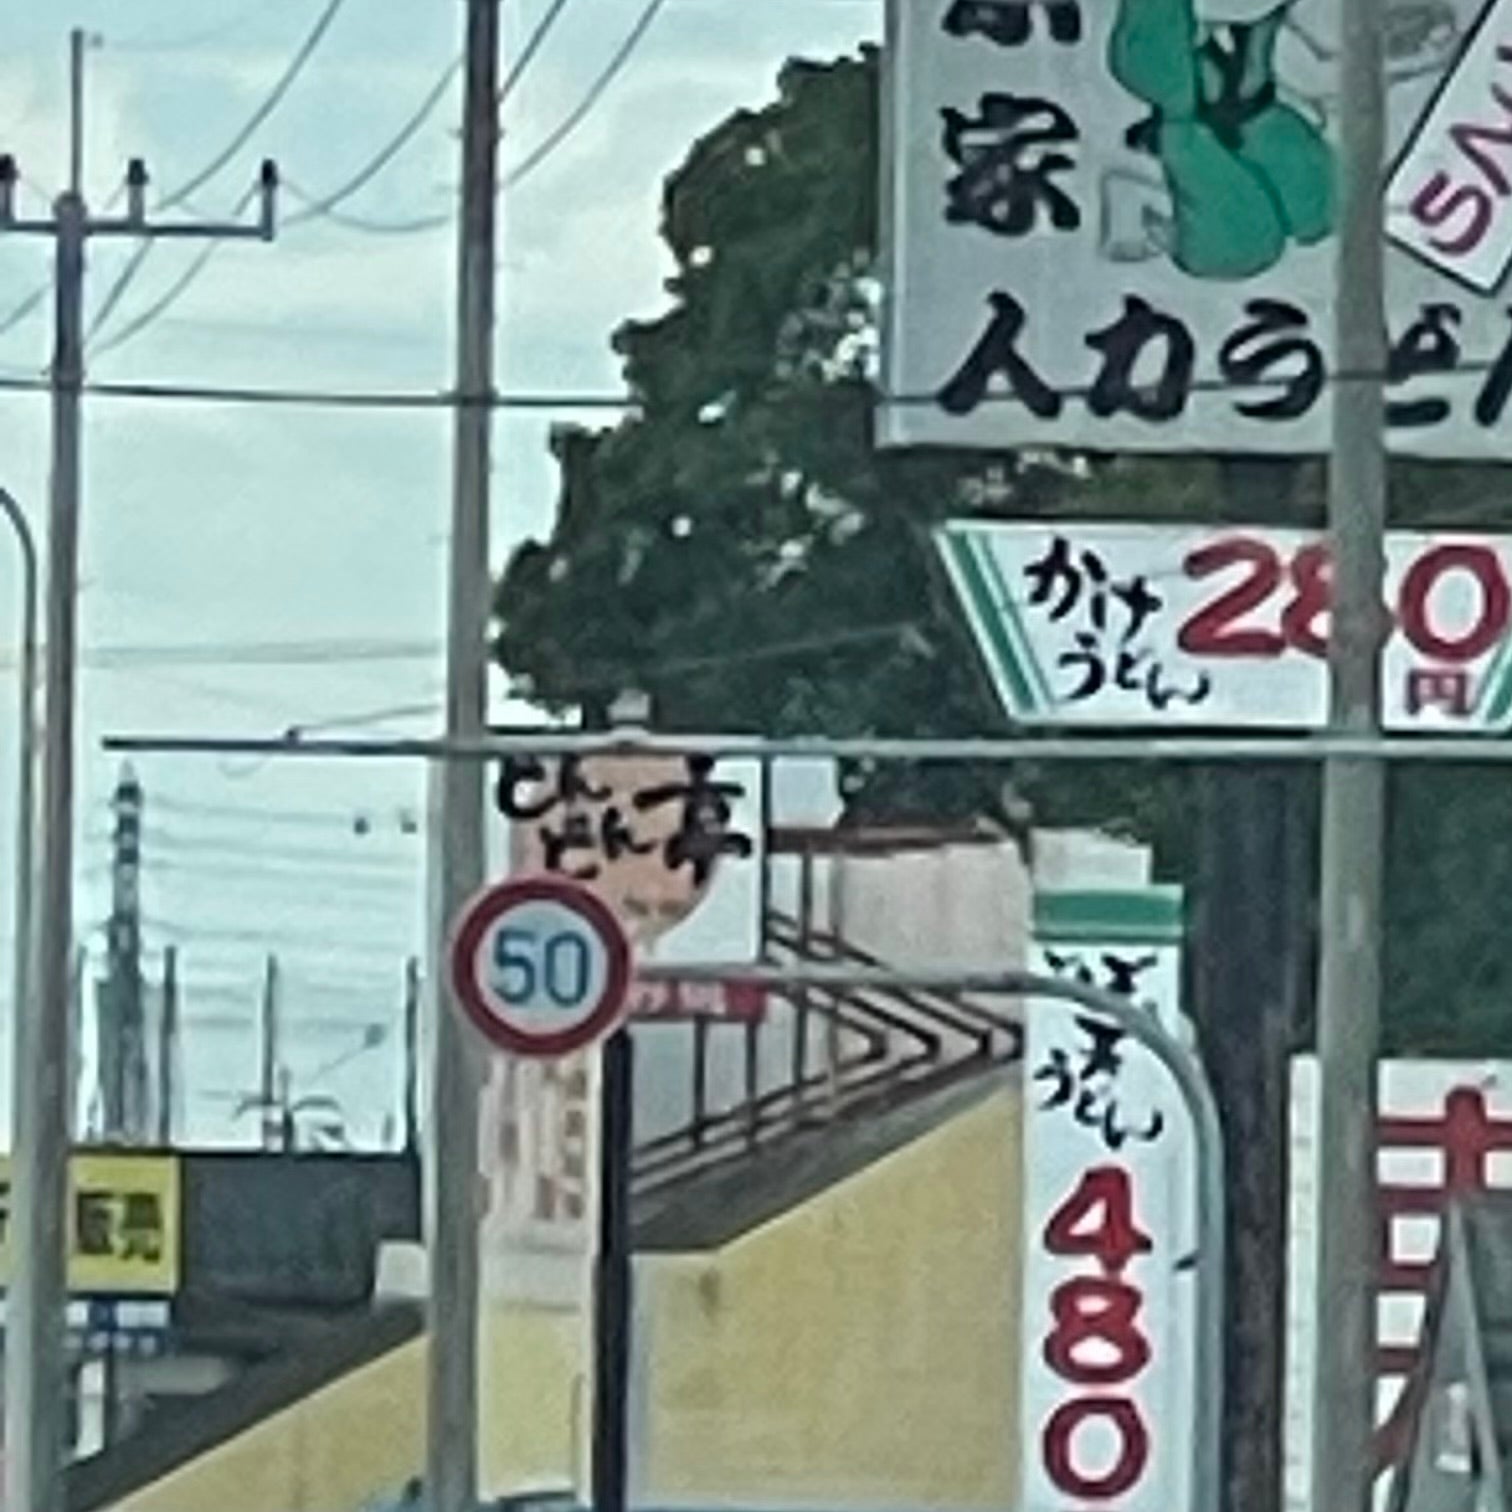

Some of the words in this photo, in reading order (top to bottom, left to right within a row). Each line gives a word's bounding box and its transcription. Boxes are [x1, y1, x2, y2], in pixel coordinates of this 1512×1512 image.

[1023, 536, 1163, 643] かけ
[1057, 631, 1211, 710] うどん
[493, 925, 590, 1007] 50
[1042, 1165, 1153, 1500] 480
